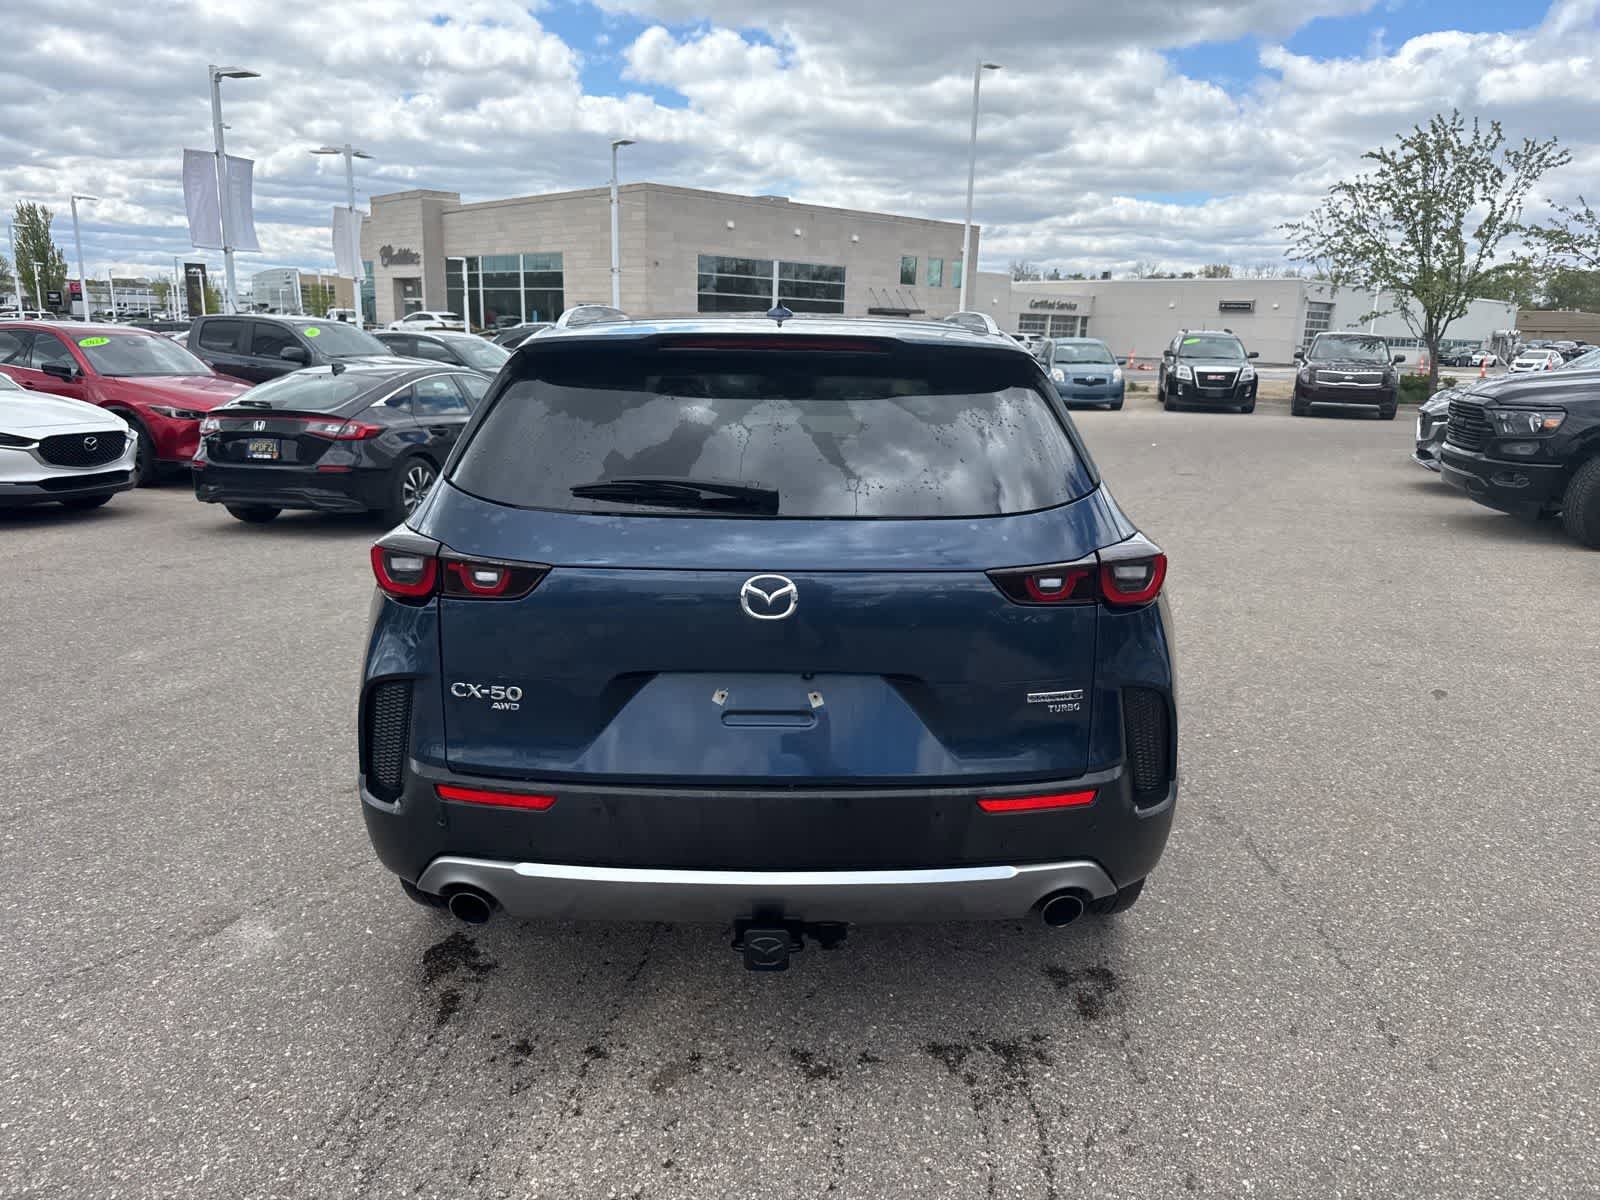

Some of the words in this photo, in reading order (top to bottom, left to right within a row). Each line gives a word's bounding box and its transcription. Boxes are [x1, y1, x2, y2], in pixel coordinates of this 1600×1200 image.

[1029, 299, 1056, 310] Certified
[1056, 300, 1078, 311] Service
[450, 682, 523, 701] CX-50
[491, 702, 520, 711] AWD
[1047, 702, 1081, 713] TURBO
